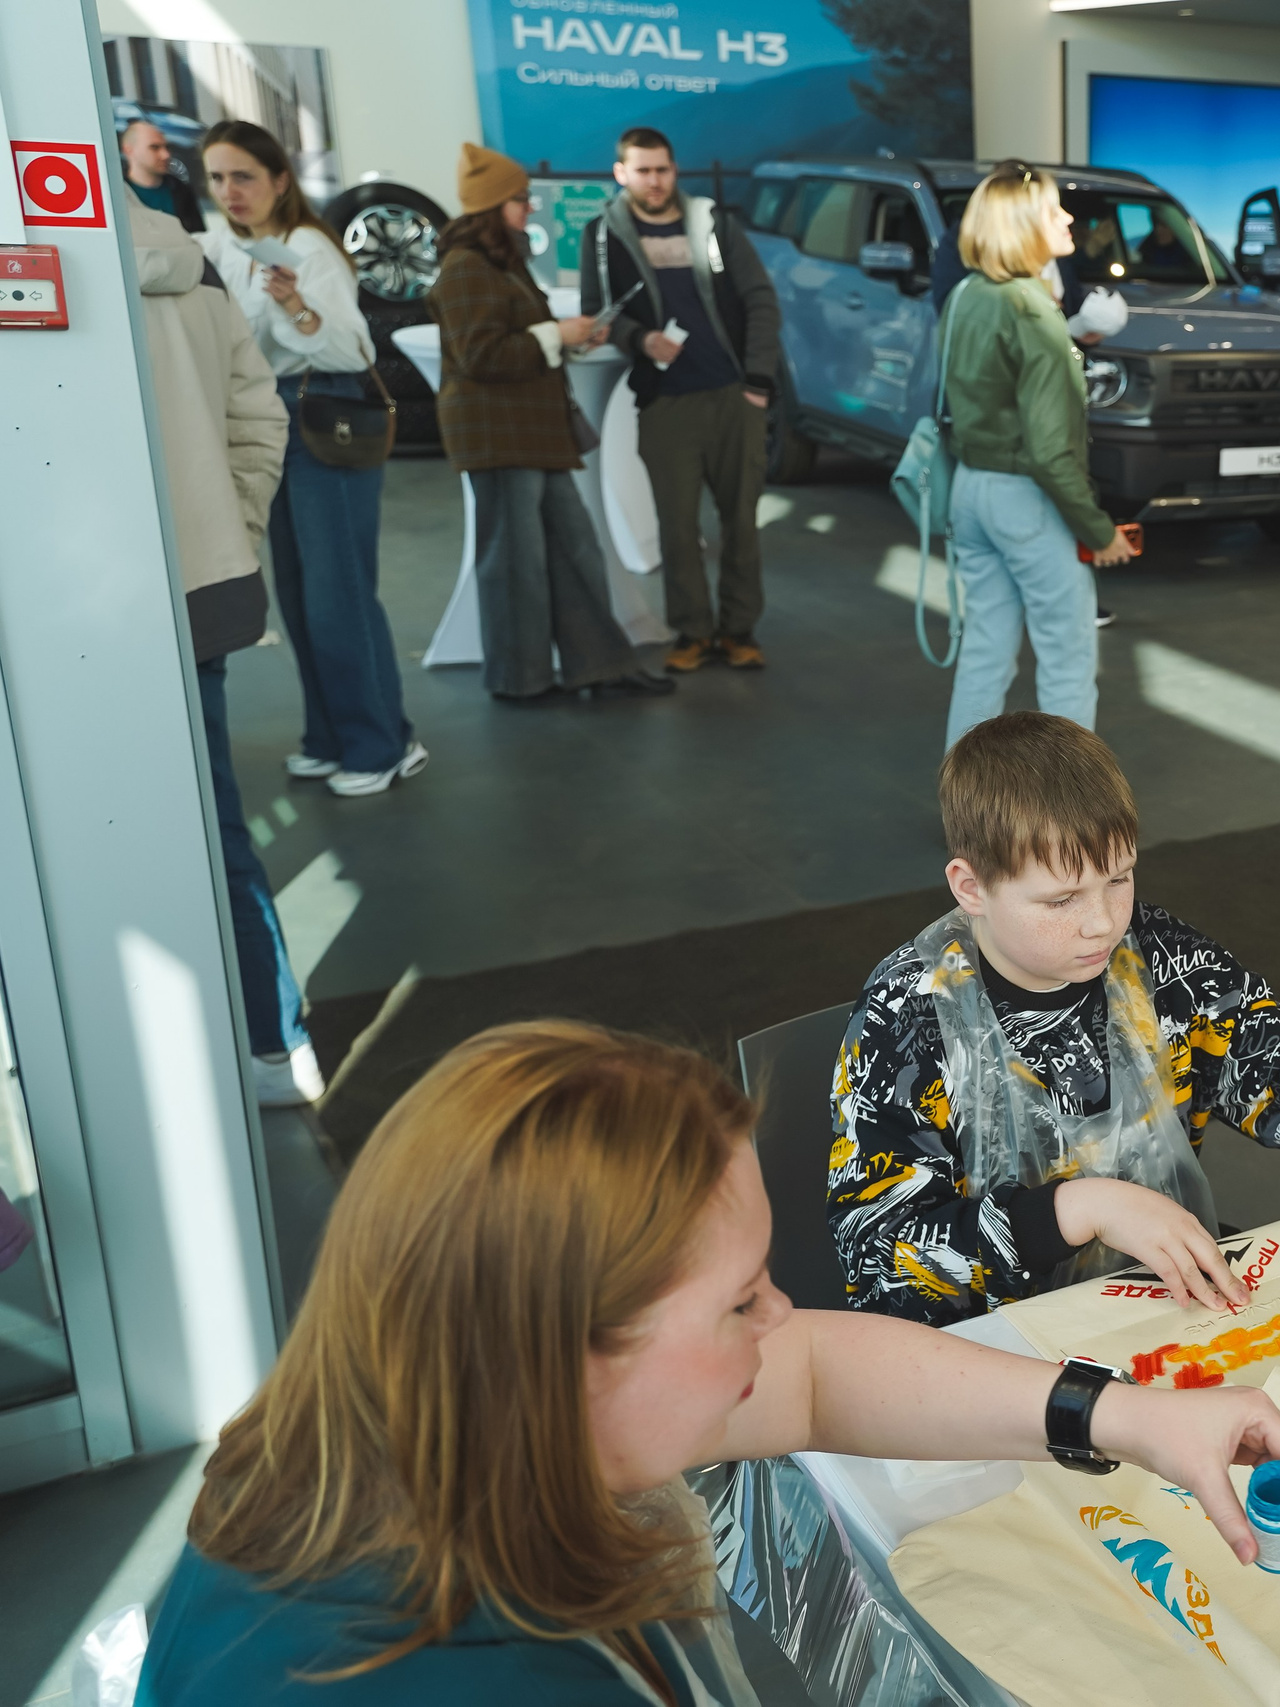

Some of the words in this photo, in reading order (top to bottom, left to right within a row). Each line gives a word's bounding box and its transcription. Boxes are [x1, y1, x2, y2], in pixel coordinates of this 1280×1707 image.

[511, 14, 704, 61] HAVAL
[716, 29, 789, 67] H3
[516, 61, 640, 89] Сильный
[643, 73, 720, 93] ответ
[1226, 1238, 1280, 1315] ПРОЙУ
